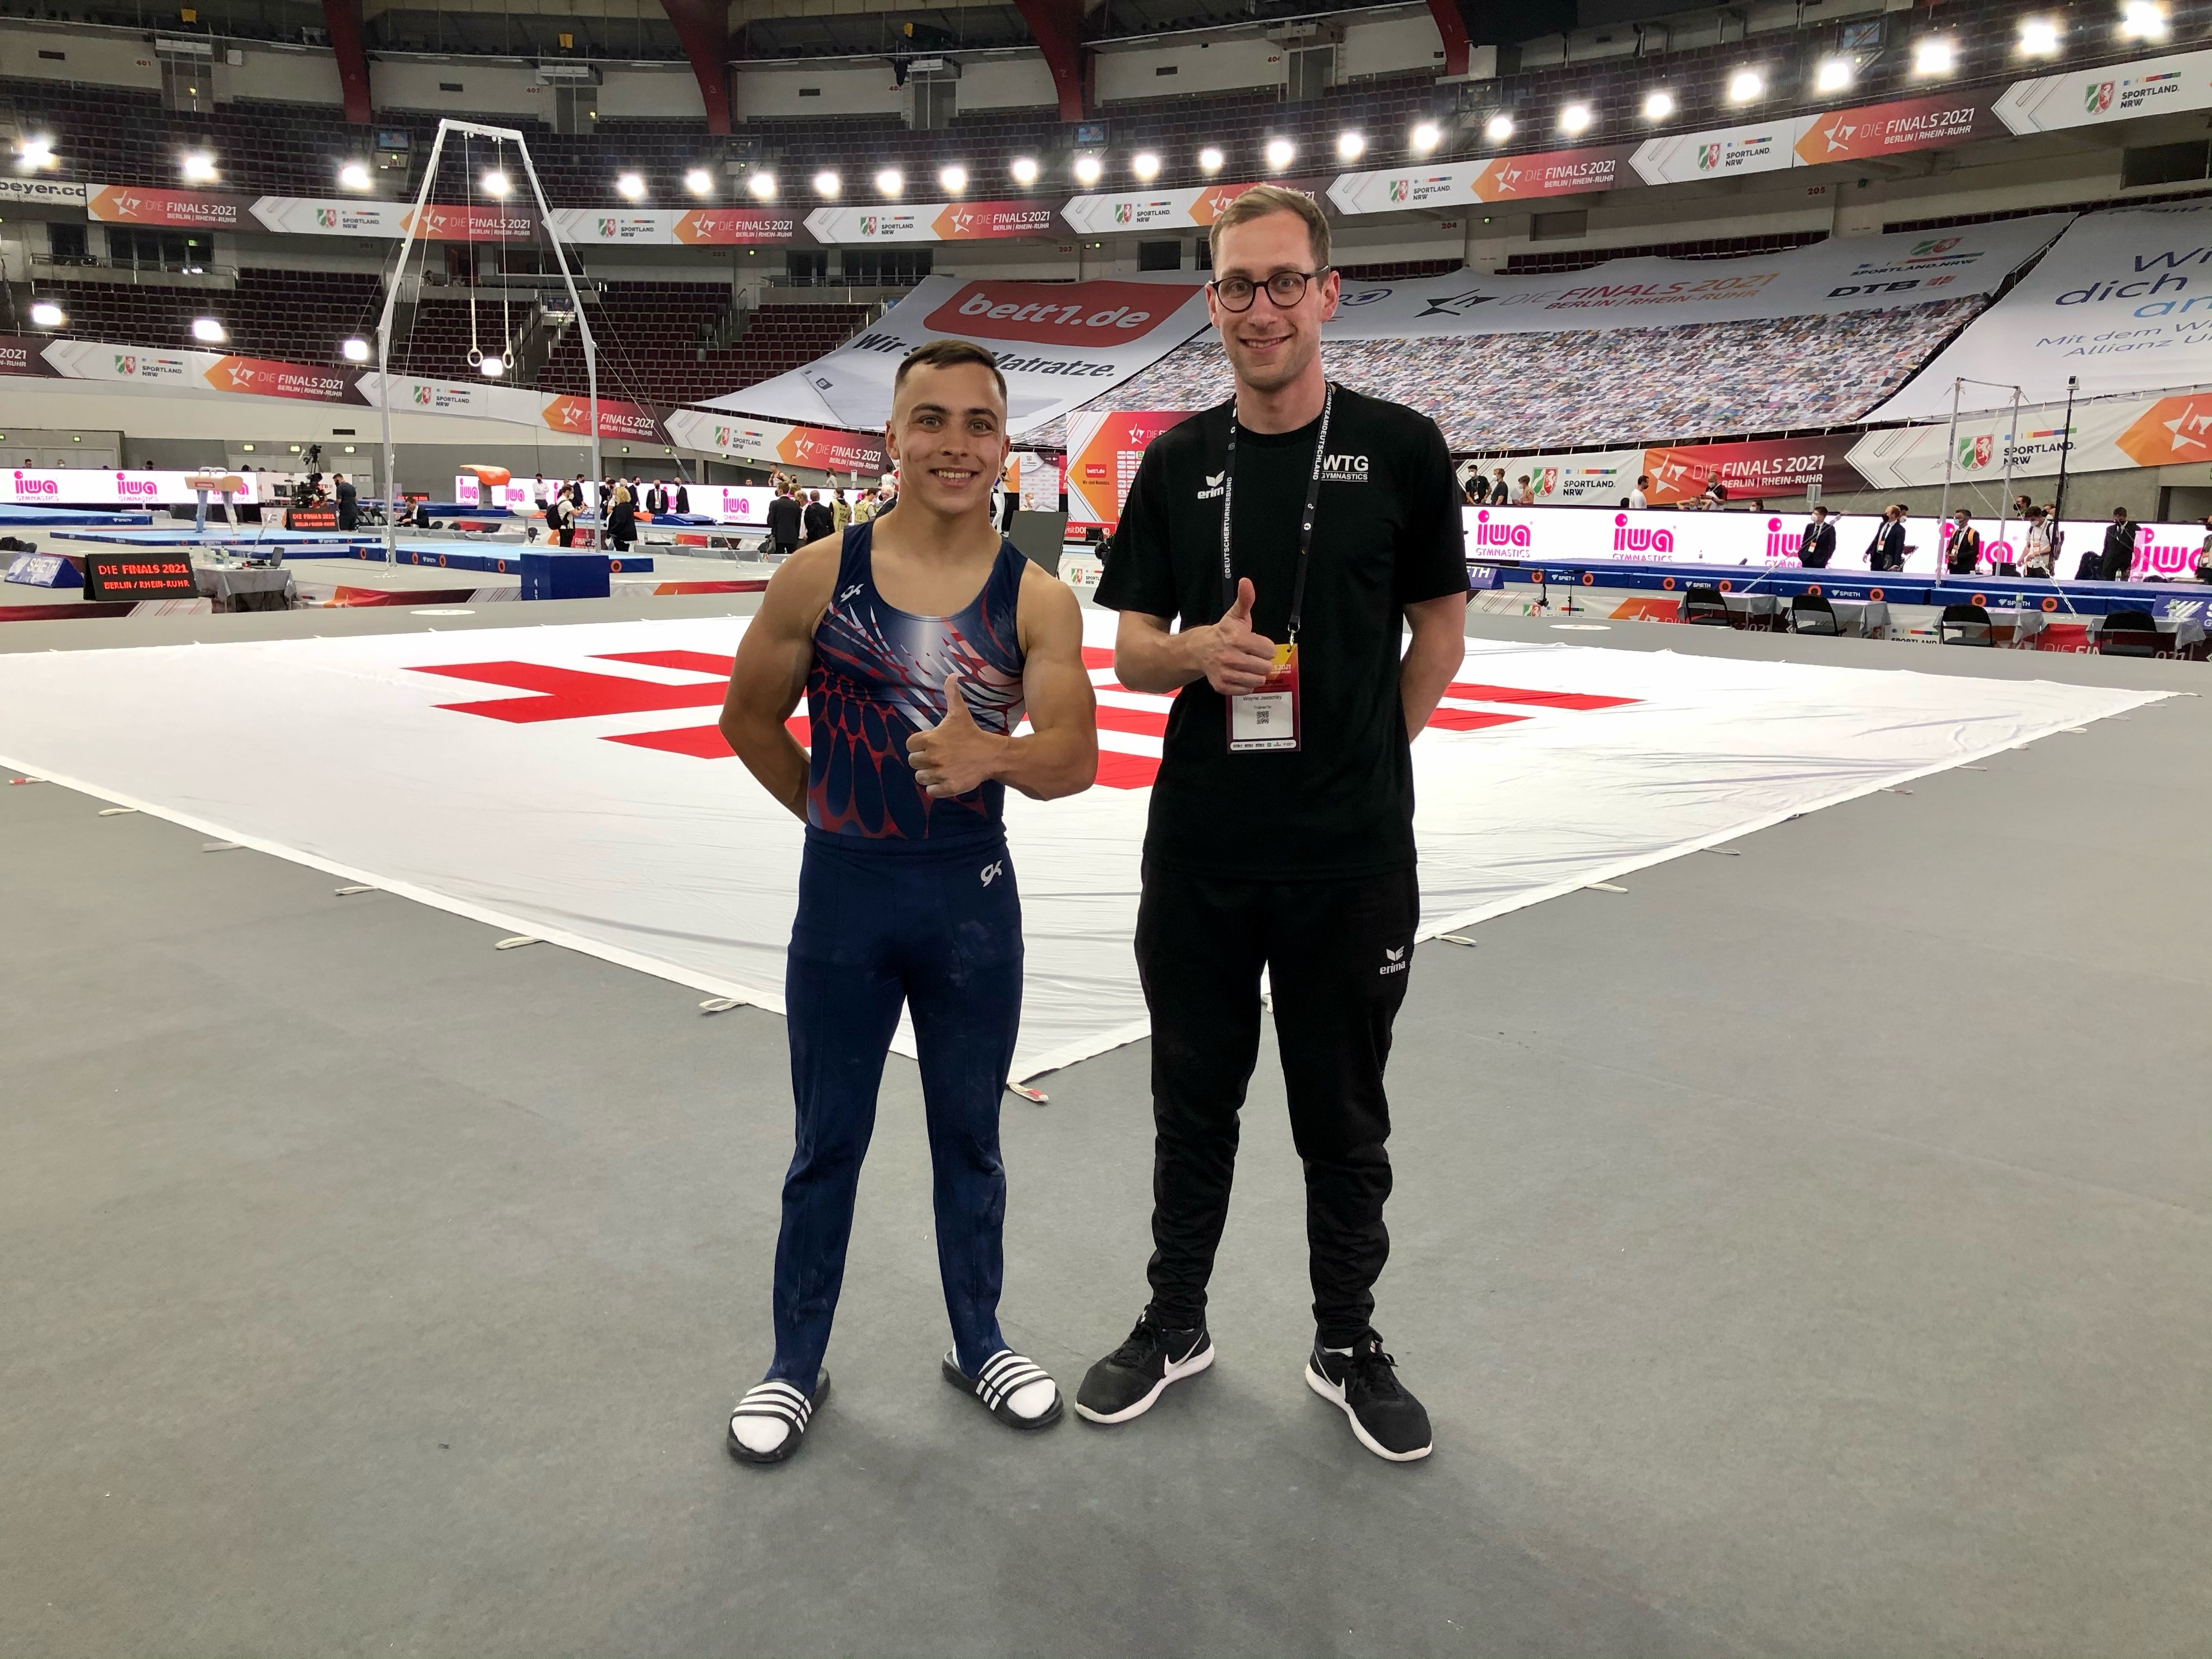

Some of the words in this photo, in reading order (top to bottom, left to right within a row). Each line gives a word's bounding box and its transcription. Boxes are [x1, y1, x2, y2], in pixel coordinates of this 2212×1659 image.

[2120, 98, 2143, 109] NRW
[1860, 121, 1884, 138] DIE
[1886, 112, 1938, 134] FINALS
[1940, 108, 1974, 126] 2021
[1884, 133, 1914, 145] BERLIN
[1918, 125, 1972, 140] RHEIN-RUHR
[1725, 158, 1743, 167] NRW
[1525, 168, 1544, 182] DIE
[1545, 163, 1587, 179] FINALS
[1588, 160, 1616, 175] 2021
[1544, 179, 1567, 188] BERLIN
[1572, 174, 1614, 185] RHEIN-RUHR
[1807, 187, 1826, 195] 205
[145, 200, 163, 211] DIE
[166, 202, 208, 214] FINALS
[211, 205, 236, 216] 2021
[195, 215, 236, 223] RHEIN-RUHR
[450, 217, 466, 227] DIE
[470, 218, 506, 229] FINALS
[508, 219, 531, 229] 2021
[977, 215, 991, 224] DIE
[993, 213, 1028, 223] FINALS
[1029, 211, 1050, 222] 2021
[719, 221, 734, 231] DIE
[736, 221, 770, 230] FINALS
[771, 221, 793, 230] 2021
[1556, 281, 1691, 301] FINALS
[1692, 272, 1781, 291] 2021
[1827, 279, 1921, 297] DTB
[2055, 273, 2188, 306] dich
[1544, 298, 1613, 309] BERLIN
[1628, 290, 1760, 306] RHEIN-RUHR
[959, 293, 1150, 329] bett1.de
[853, 334, 907, 353] Wir
[2036, 335, 2087, 347] Mit
[2094, 329, 2162, 342] dem
[2062, 339, 2174, 357] Allianz
[258, 371, 275, 382] DIE
[278, 374, 318, 387] FINALS
[319, 378, 344, 390] 2021
[304, 387, 343, 397] RHEIN-RUHR
[585, 410, 600, 422] DE
[601, 414, 634, 426] FINALS
[634, 417, 654, 429] 2021
[1147, 430, 1158, 439] DIE
[816, 443, 831, 455] DIE
[830, 445, 862, 459] FINALS
[862, 449, 881, 462] 2021
[829, 457, 847, 465] BERLIN
[849, 460, 879, 470] RHEIN-RUHR
[1722, 458, 1783, 477] FINALS
[1785, 455, 1825, 473] 2021
[1722, 478, 1754, 489] BERLIN
[1762, 474, 1823, 487] RHEIN-RUHR
[1198, 486, 1224, 499] erim
[1476, 548, 1530, 558] GYMNASTICS
[27, 558, 59, 574] SPIETH
[98, 565, 118, 575] DIE
[122, 565, 160, 574] FINALS
[162, 564, 189, 574] 2021
[104, 580, 132, 590] BERLIN
[1379, 961, 1406, 975] erima
